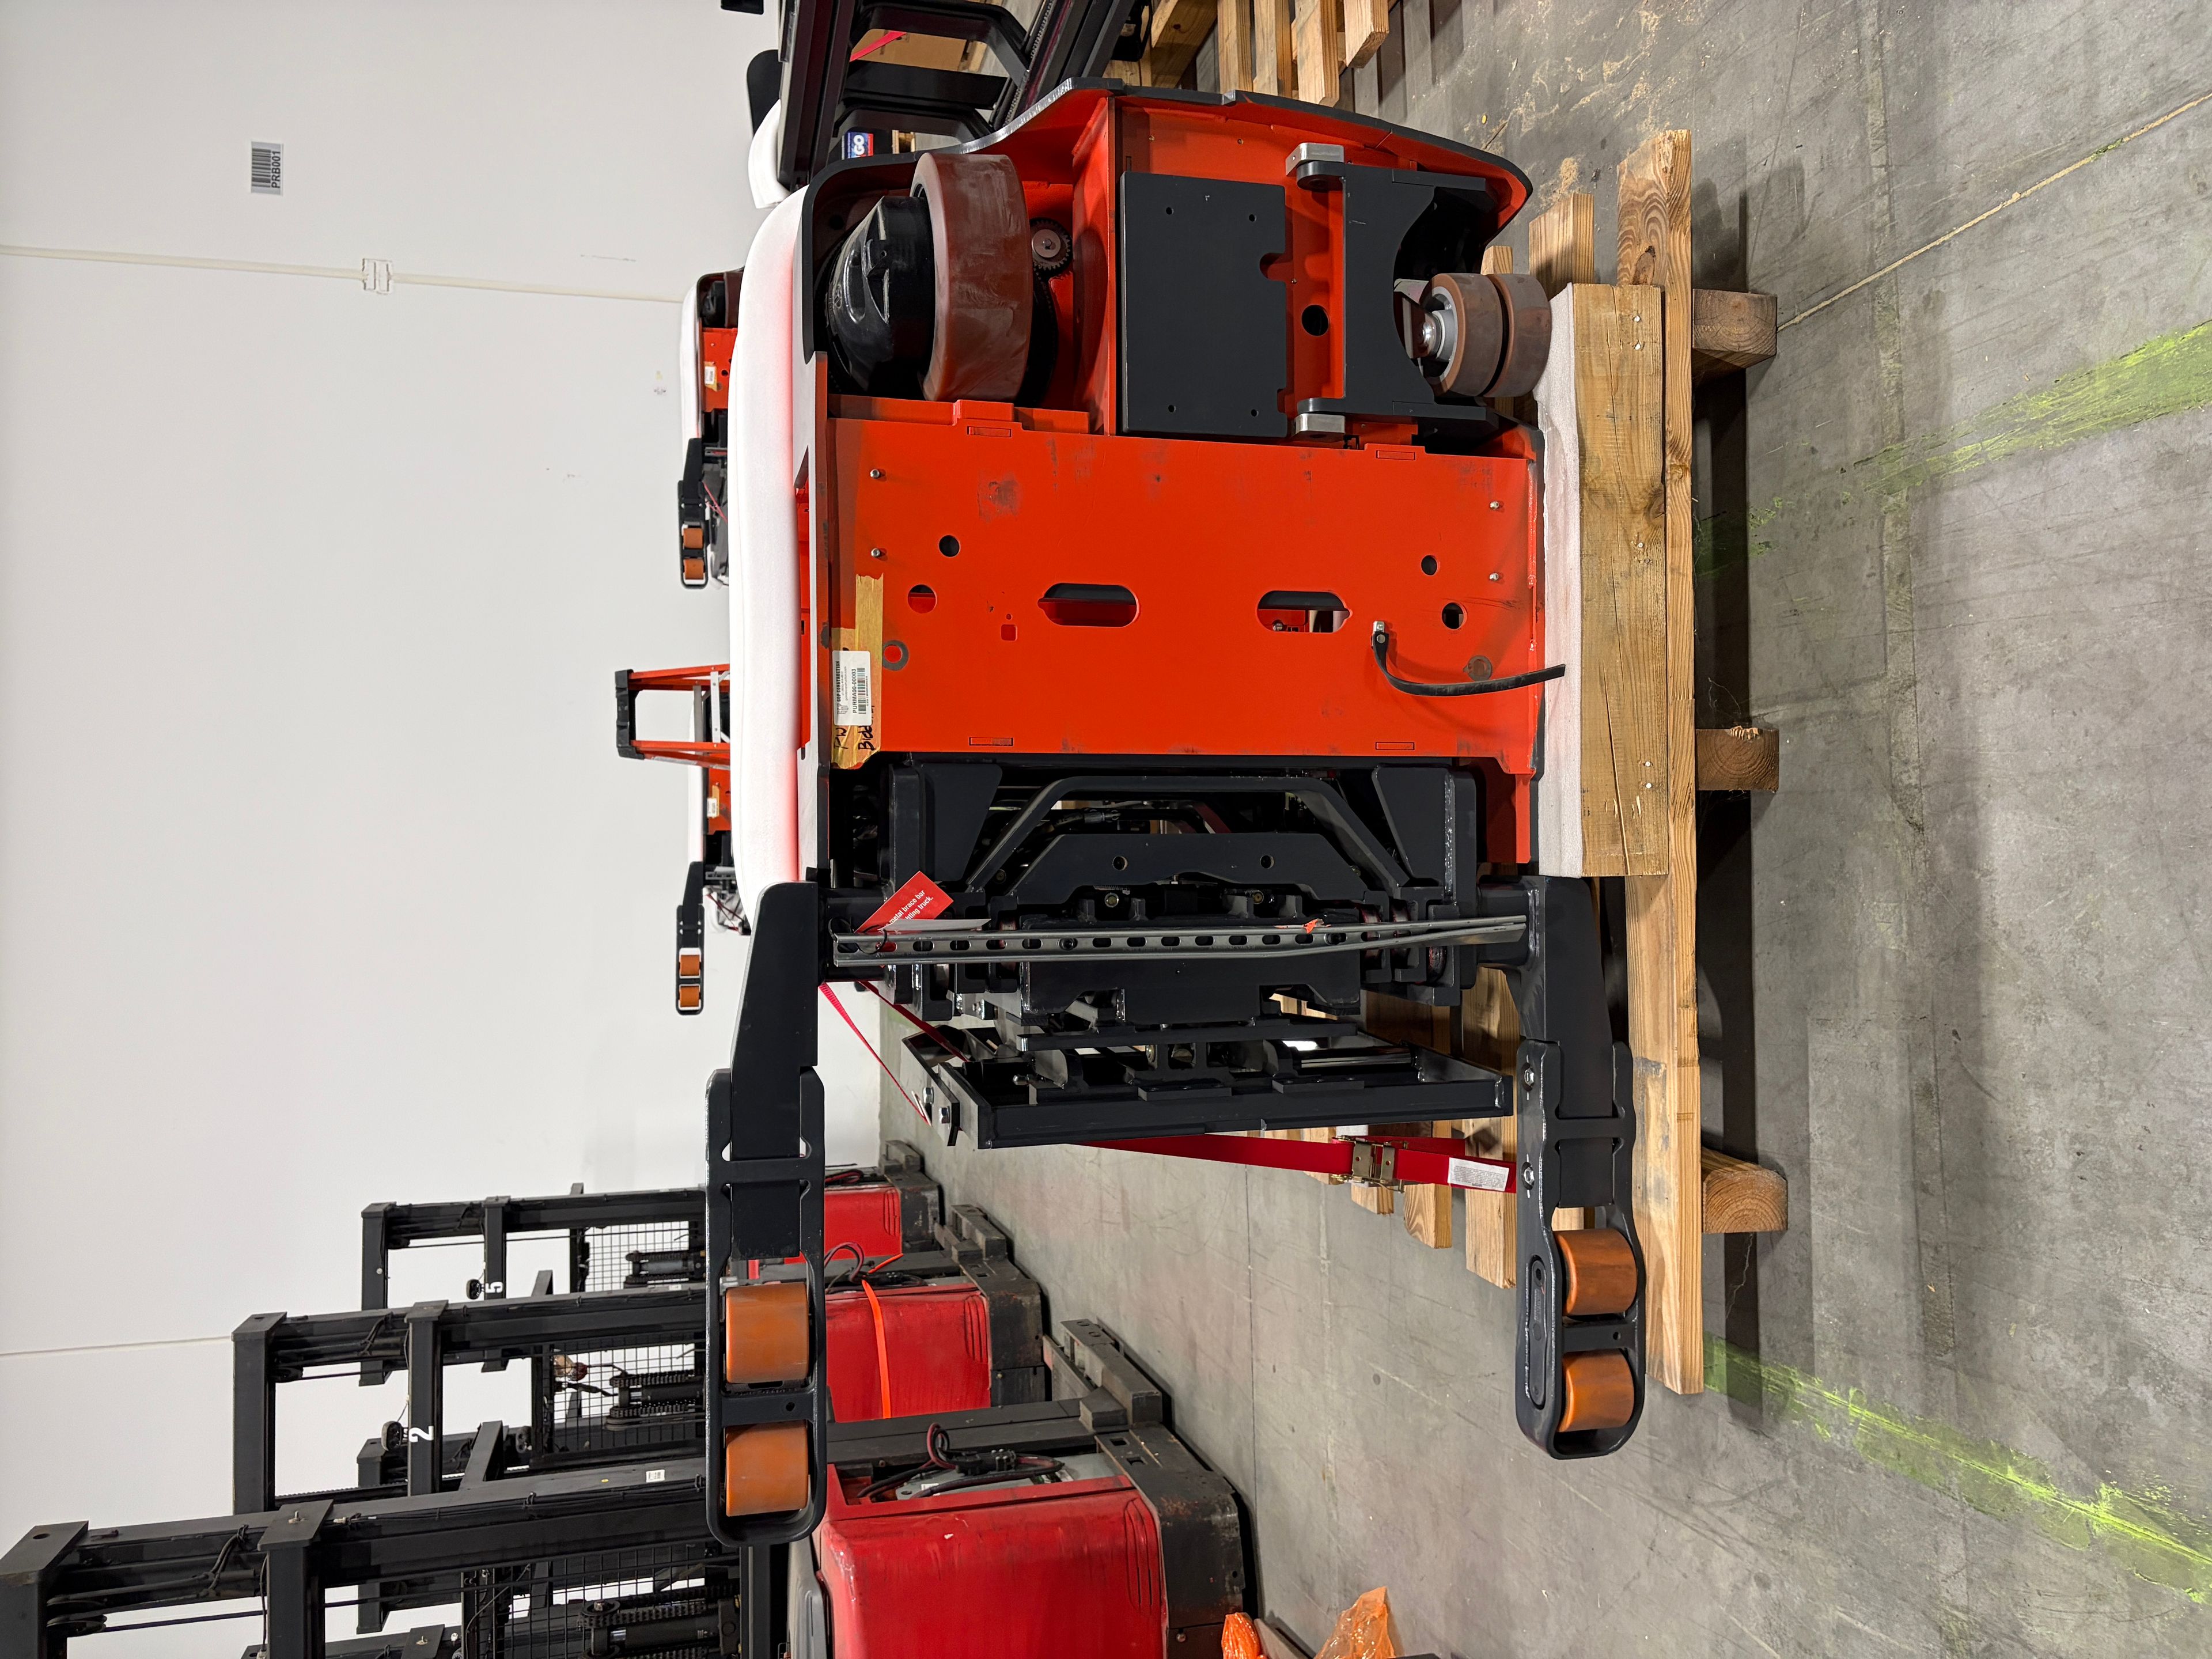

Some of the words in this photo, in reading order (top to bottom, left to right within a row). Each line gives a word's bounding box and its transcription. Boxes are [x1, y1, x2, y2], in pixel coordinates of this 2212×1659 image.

[271, 151, 281, 188] PRB001
[915, 889, 926, 901] bar
[918, 896, 934, 910] truck.
[485, 1281, 503, 1293] 5
[409, 1426, 434, 1442] 2
